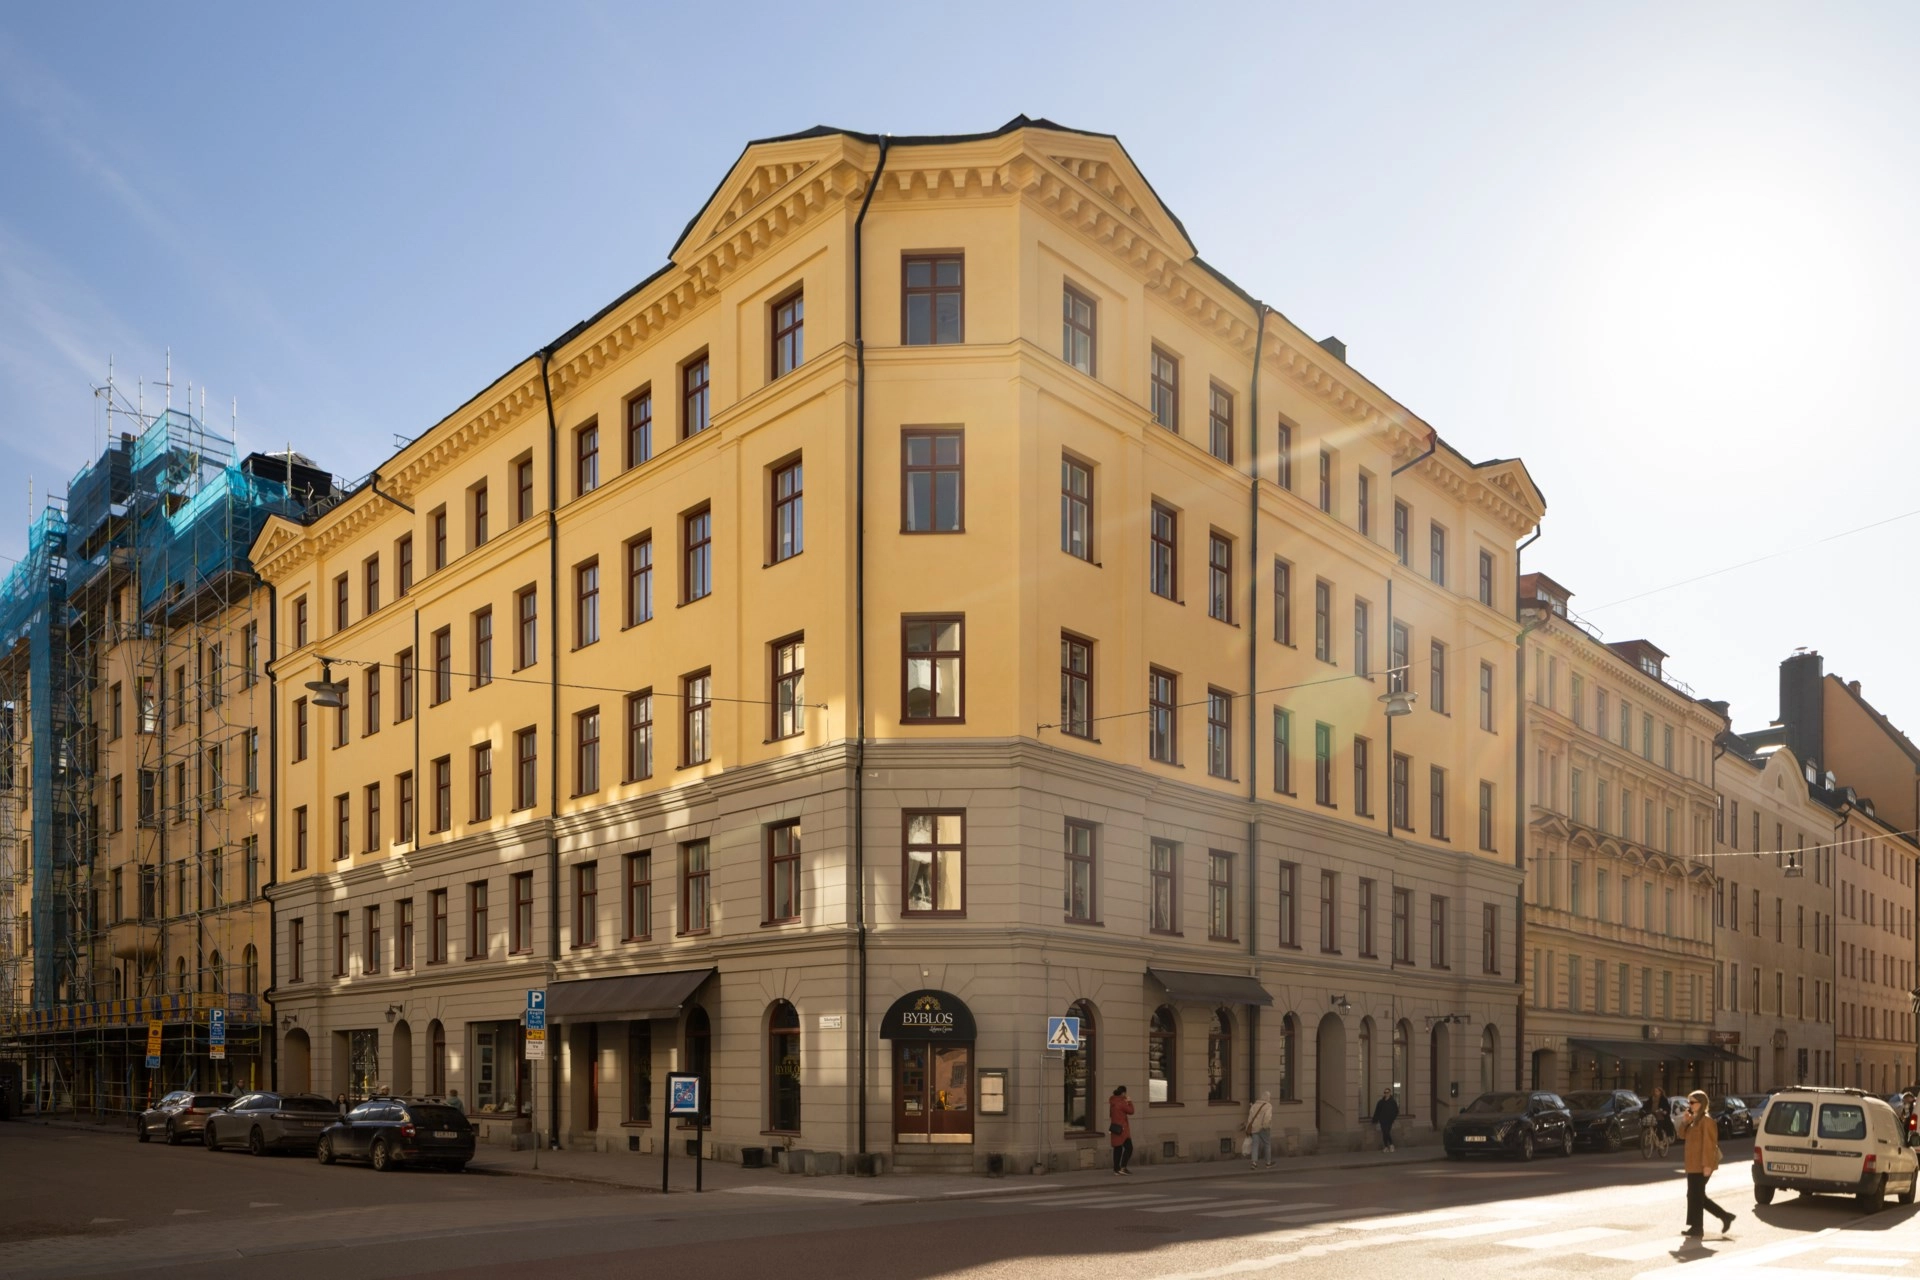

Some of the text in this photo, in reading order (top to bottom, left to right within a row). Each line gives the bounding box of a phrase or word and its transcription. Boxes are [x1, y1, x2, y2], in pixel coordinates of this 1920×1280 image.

[532, 992, 542, 1008] P
[213, 1010, 222, 1021] P
[903, 1012, 953, 1024] BYBLOS
